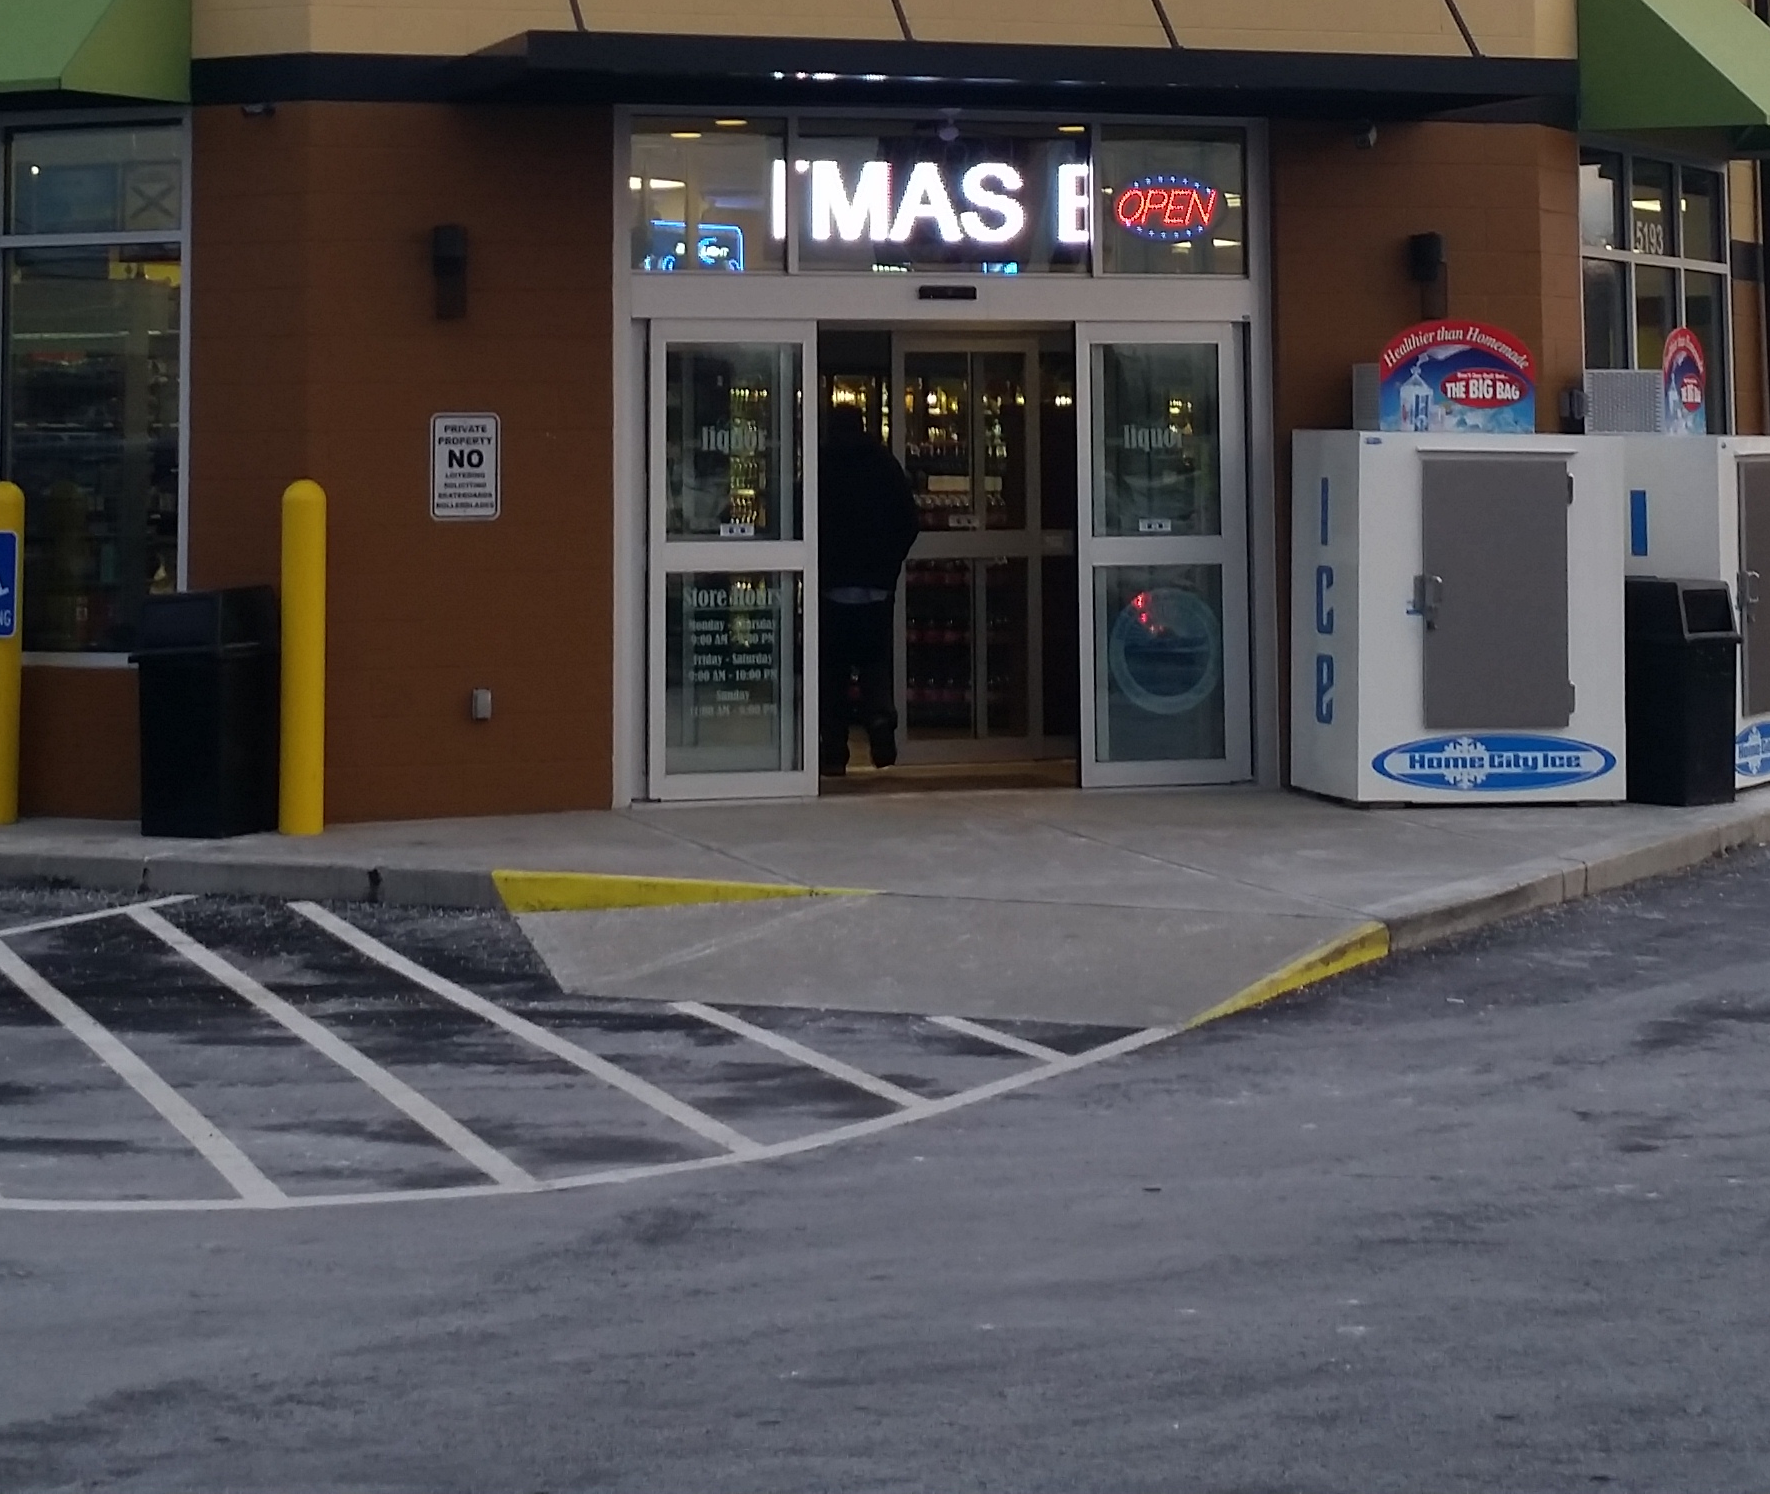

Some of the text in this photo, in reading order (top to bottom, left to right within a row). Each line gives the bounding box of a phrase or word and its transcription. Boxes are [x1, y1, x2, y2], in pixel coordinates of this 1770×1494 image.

[1118, 188, 1216, 226] OPEN
[1636, 221, 1664, 255] 5193
[1383, 326, 1529, 369] Healthier than Homemade
[1445, 378, 1520, 400] THE BIG BAG
[444, 424, 488, 434] PRIVATE
[438, 436, 492, 446] PROPERTY
[702, 425, 768, 455] liquor
[448, 449, 485, 468] NO
[683, 587, 728, 608] Store
[693, 653, 723, 666] Friday
[732, 652, 772, 666] Saturday
[712, 669, 727, 681] AM
[736, 669, 761, 681] 10:00
[1408, 753, 1582, 771] Home City Ice
